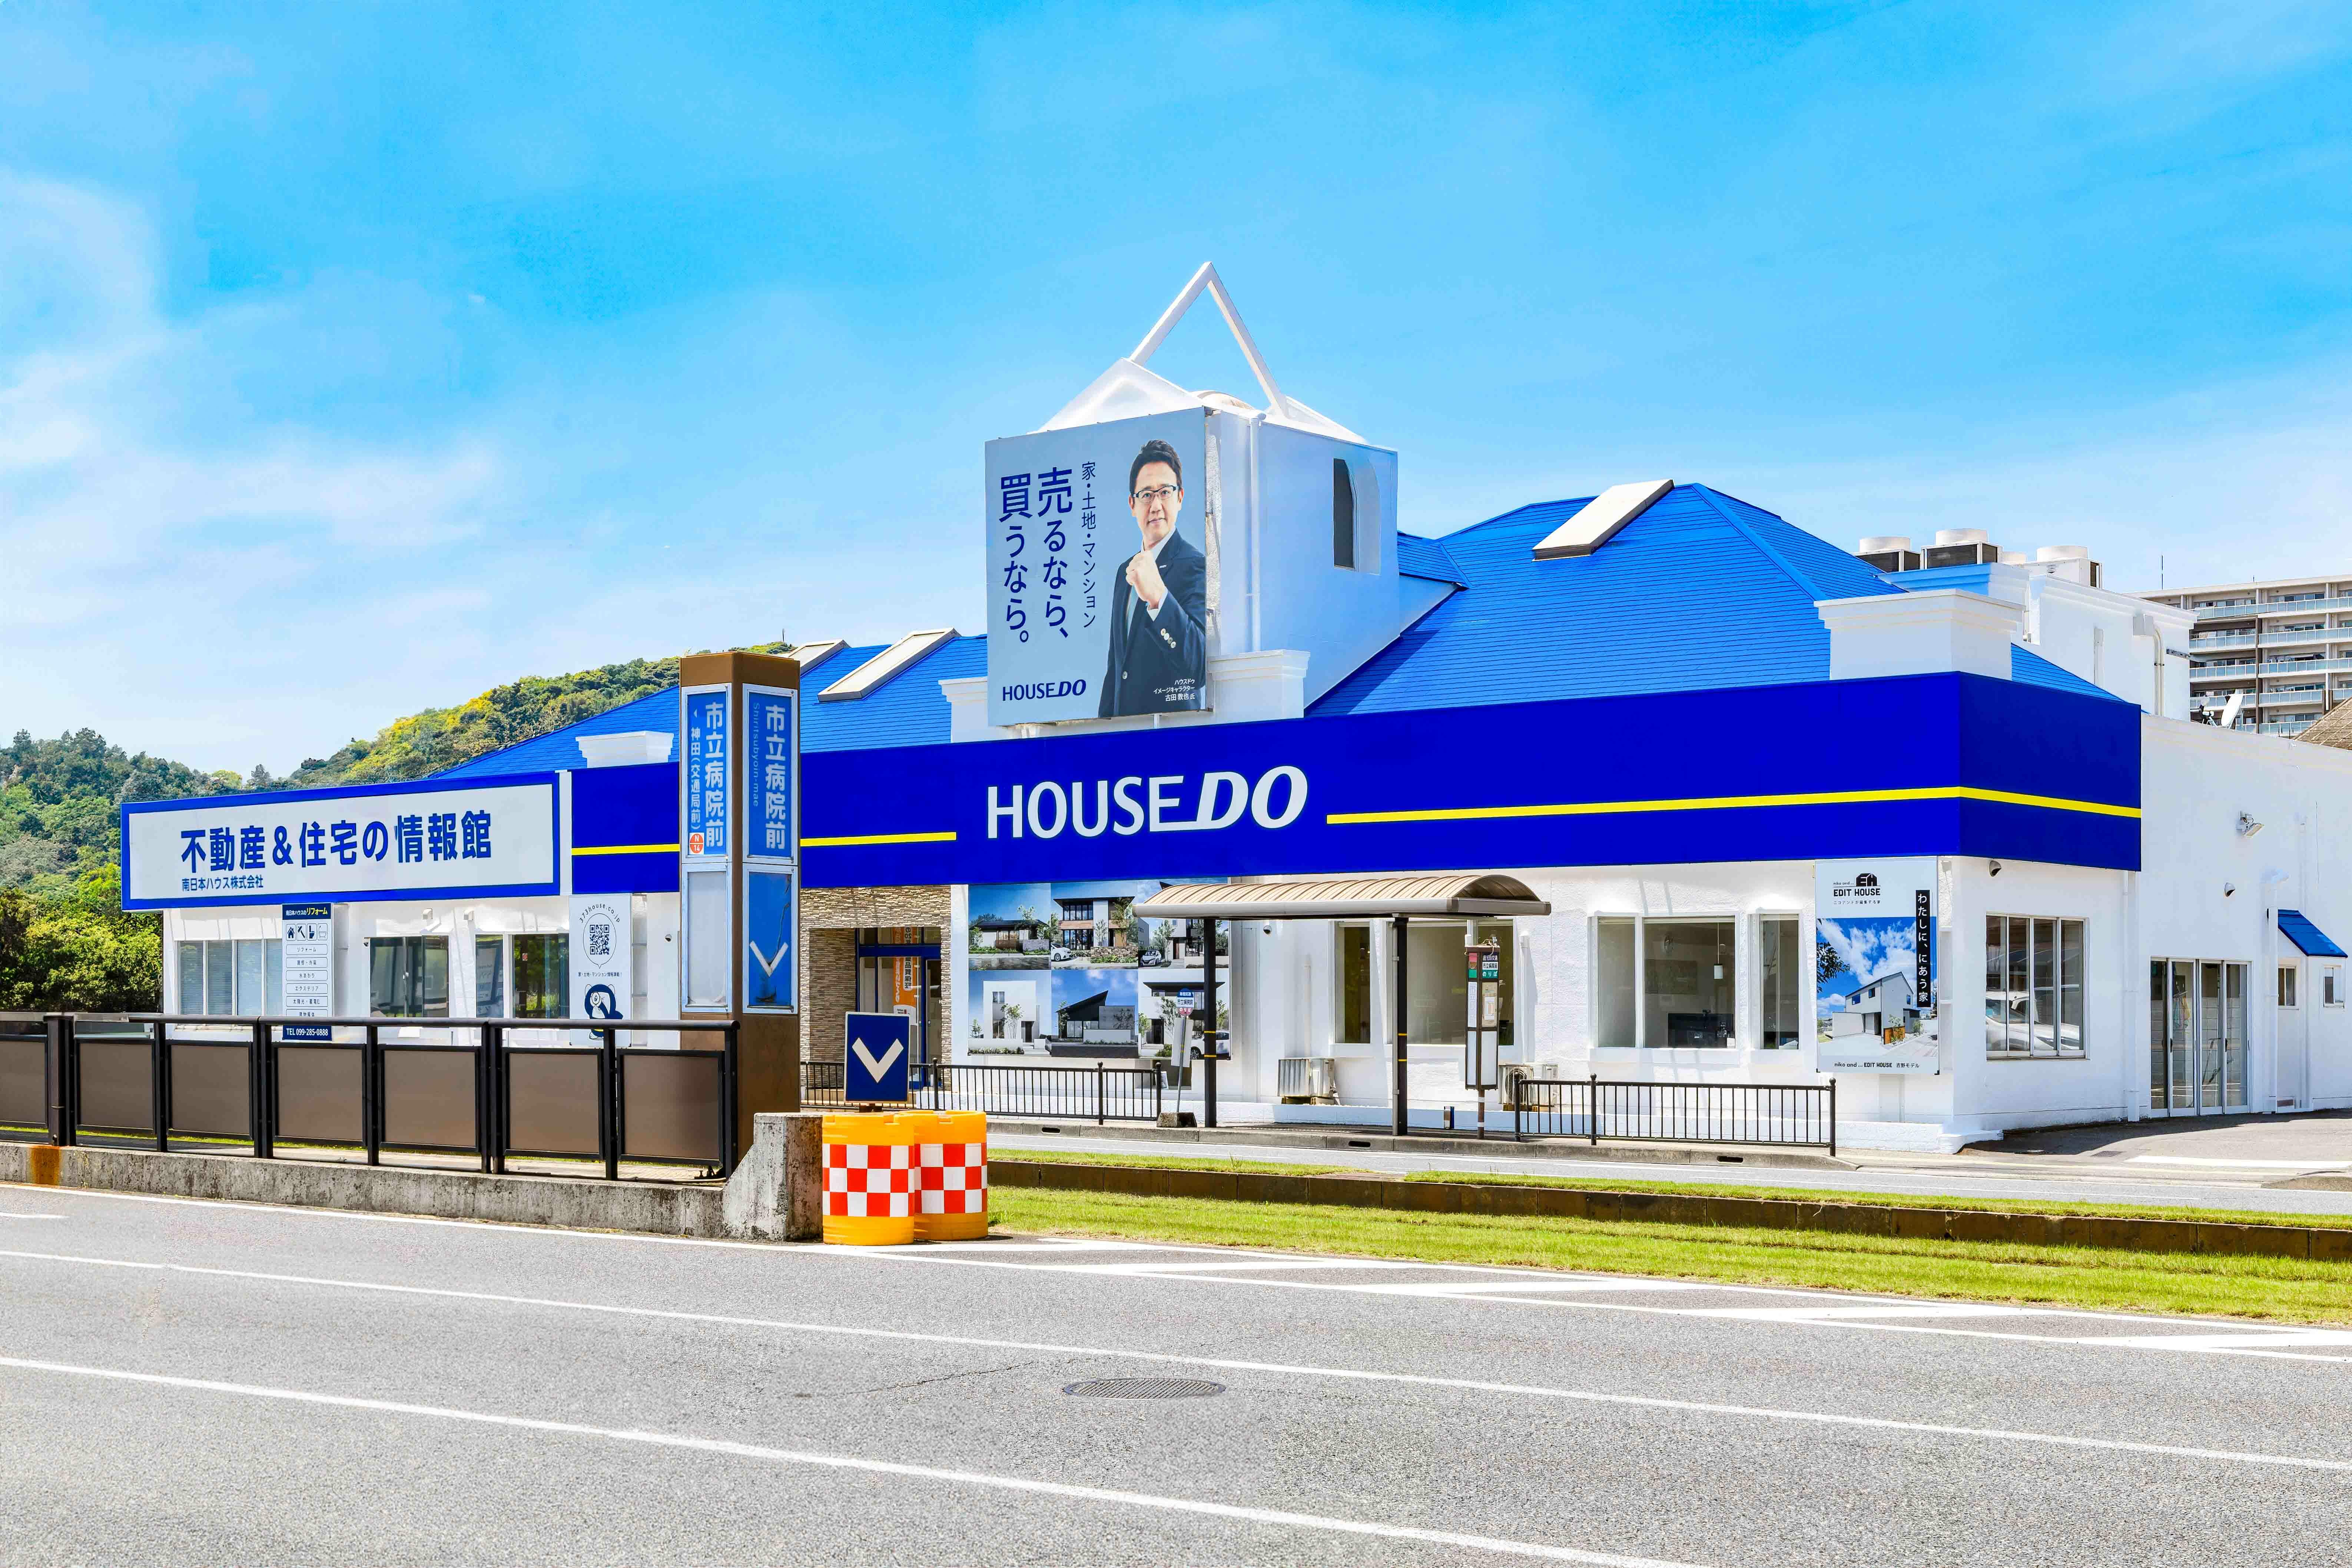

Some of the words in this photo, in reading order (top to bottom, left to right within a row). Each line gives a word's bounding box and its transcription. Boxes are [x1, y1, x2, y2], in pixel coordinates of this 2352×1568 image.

[999, 473, 1033, 642] 買うなら。
[1038, 467, 1073, 638] 売るなら、
[1082, 461, 1096, 628] 家・土地・マンション
[1154, 686, 1195, 694] イメージキャラクター
[705, 702, 724, 848] 市立病院前
[766, 705, 786, 849] 市立病院前
[180, 810, 492, 873] 不動産&住宅の情報館
[182, 875, 263, 891] 南日本ハウス株式会社
[579, 904, 620, 923] 373house.co.jp
[1918, 894, 1928, 1002] わたしに、にあう家
